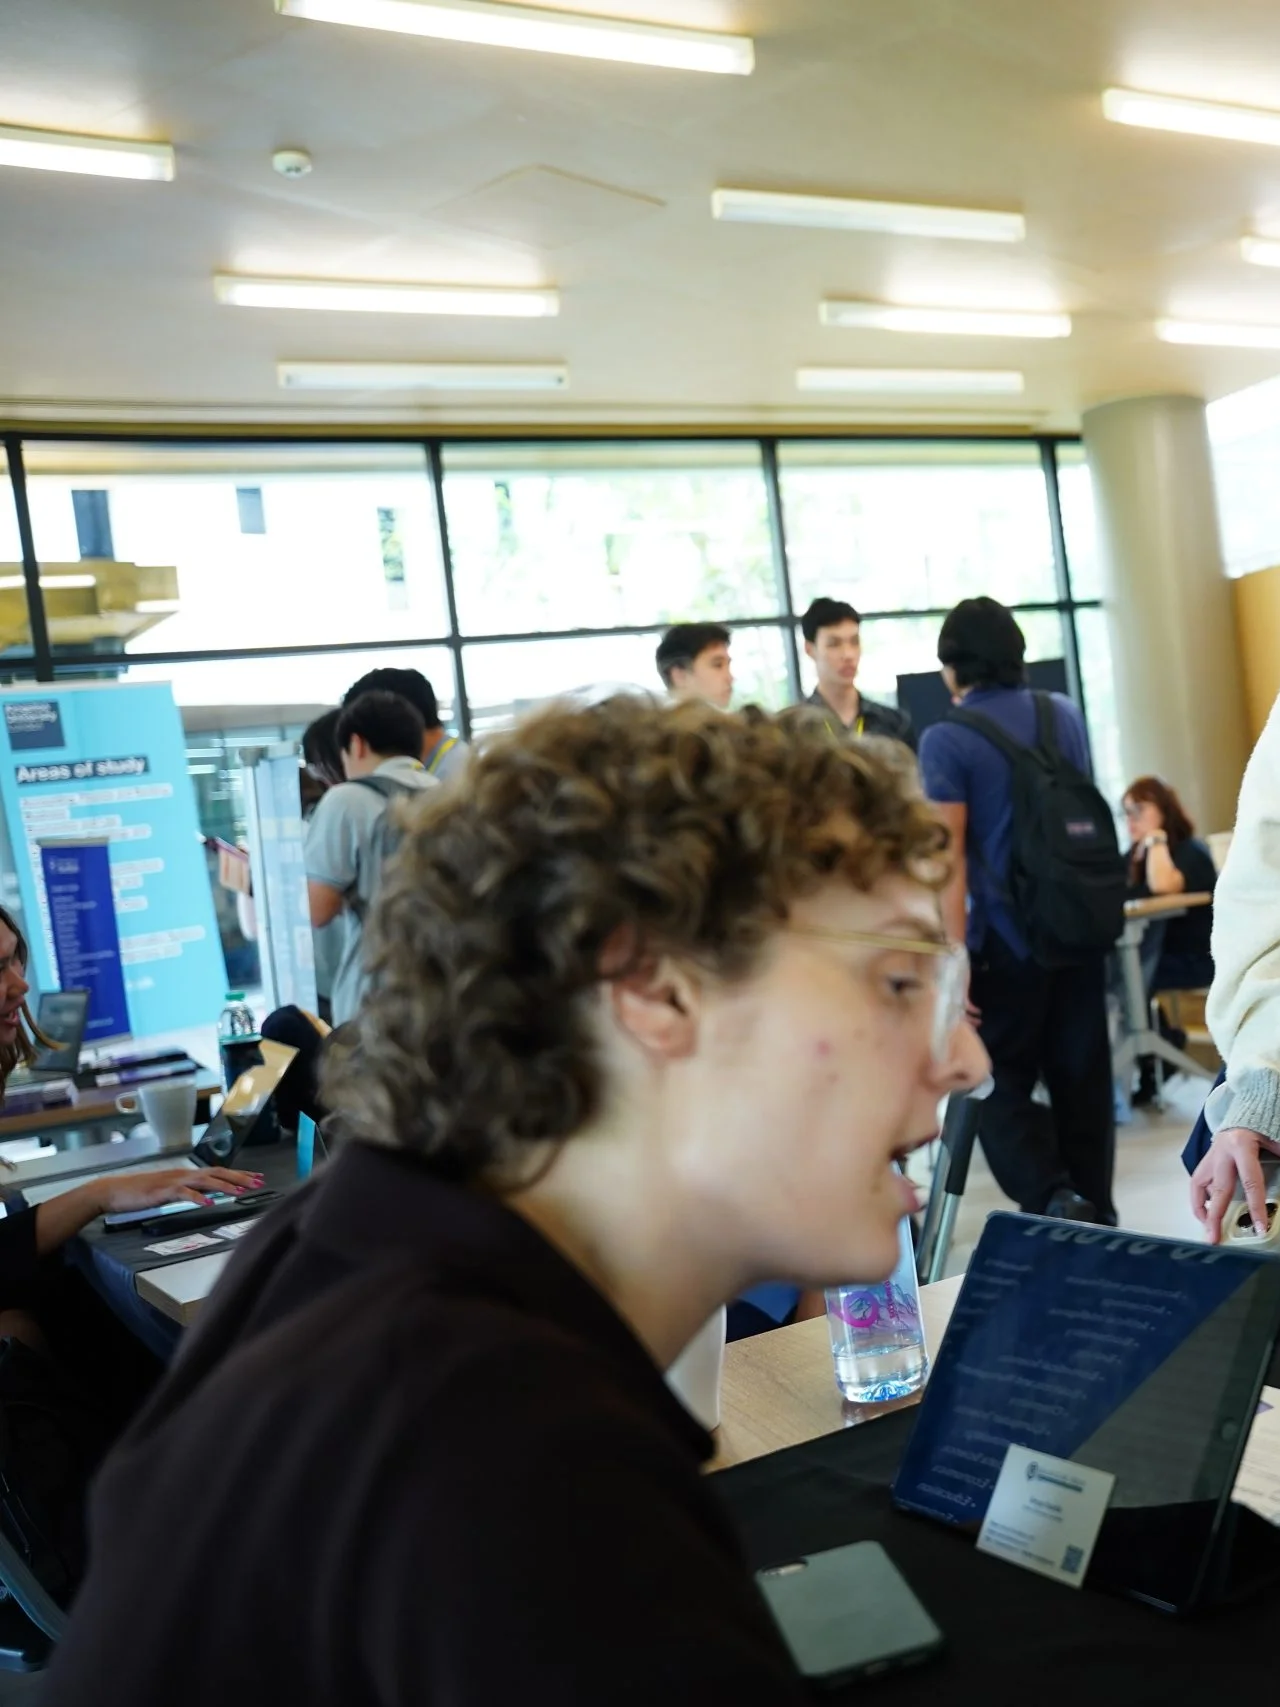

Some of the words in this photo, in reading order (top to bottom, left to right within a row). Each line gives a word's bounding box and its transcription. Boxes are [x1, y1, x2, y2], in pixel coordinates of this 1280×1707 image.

[16, 763, 72, 783] Areas
[73, 760, 94, 778] of
[95, 755, 146, 776] study
